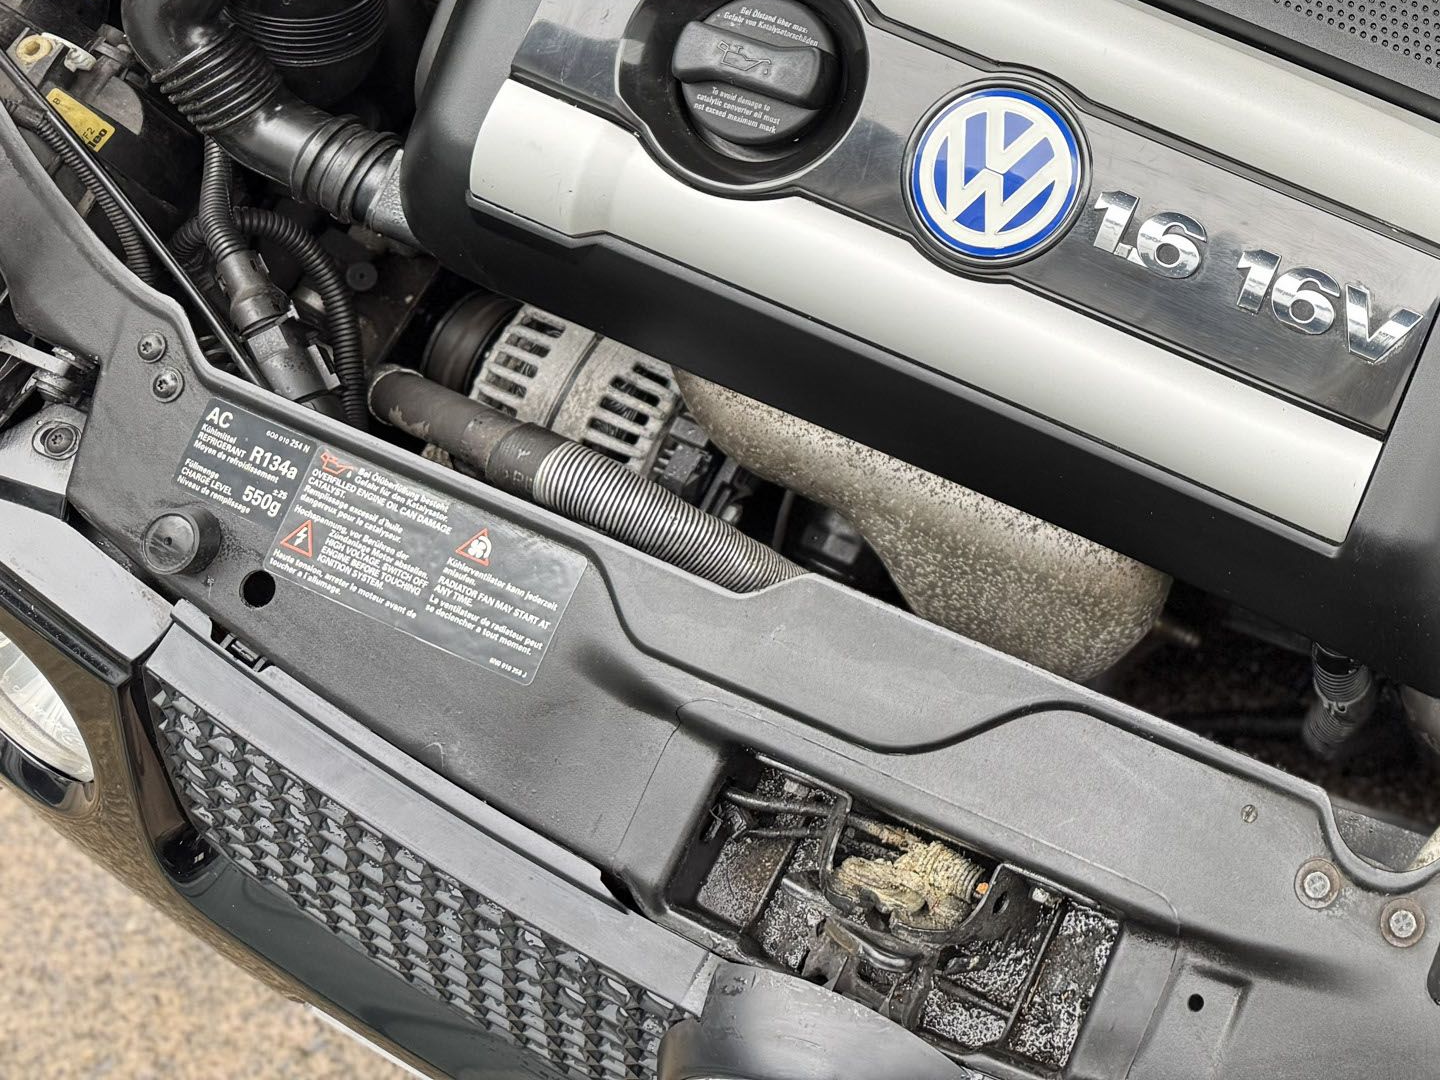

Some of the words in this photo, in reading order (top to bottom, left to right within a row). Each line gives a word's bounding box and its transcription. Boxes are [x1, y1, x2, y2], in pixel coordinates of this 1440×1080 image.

[724, 11, 744, 24] Gefahr
[740, 6, 751, 16] Bei
[697, 93, 722, 108] catalytic
[723, 101, 753, 116] converter
[763, 114, 781, 126] must
[720, 88, 737, 101] avoid
[738, 95, 763, 110] damage
[705, 105, 727, 119] exceed
[727, 112, 758, 129] maximum
[758, 122, 777, 134] mark
[920, 96, 1076, 247] VW
[1234, 246, 1423, 364] 16V
[198, 432, 246, 458] REFRIGERANT
[202, 423, 237, 444] Kühlmittel
[185, 458, 219, 479] Füllmenge
[194, 440, 216, 455] Moyen
[226, 456, 279, 483] refroidissement
[249, 446, 298, 480] R134a
[177, 475, 200, 491] Niveau
[210, 492, 250, 513] remplissage
[182, 467, 212, 485] CHARGE
[210, 480, 231, 495] LEVEL
[308, 477, 346, 498] CATALYST.
[354, 476, 378, 491] Gefahr
[380, 487, 391, 496] für
[391, 493, 405, 504] den
[358, 468, 372, 478] Bei
[372, 472, 422, 501] Ölüberfüllung
[420, 494, 448, 512] besteht
[242, 486, 281, 517] 550g
[300, 494, 337, 514] dangereux
[337, 511, 356, 522] pour
[303, 484, 348, 509] Remplissage
[349, 506, 379, 522] excessif
[378, 518, 403, 534] d'huile
[312, 468, 356, 492] OVERFILLED
[356, 488, 386, 506] ENGINE
[386, 501, 398, 512] OIL
[400, 507, 418, 520] CAN
[417, 514, 452, 535] DAMAGE
[328, 529, 370, 553] Zündanlage
[371, 548, 394, 563] Motor
[350, 530, 362, 539] vor
[362, 535, 395, 555] Berühren
[396, 550, 409, 560] der
[270, 558, 297, 574] toucher
[317, 554, 352, 574] IGNITION
[352, 570, 384, 590] SYSTEM.
[321, 546, 351, 564] ENGINE
[350, 559, 380, 577] BEFORE
[381, 572, 421, 596] TOUCHING
[325, 537, 345, 551] HIGH
[382, 563, 412, 582] SWITCH
[412, 576, 429, 588] OFF
[443, 567, 475, 586] anlaufen.
[273, 549, 294, 564] Haute
[358, 588, 384, 604] moteur
[385, 601, 406, 614] avant
[434, 584, 453, 597] ANY
[453, 592, 473, 607] TIME.
[446, 557, 506, 588] Kühlerventilator
[505, 583, 525, 597] kann
[524, 591, 558, 611] jederzeit
[438, 576, 478, 598] RADIATOR
[477, 593, 495, 606] FAN
[494, 600, 514, 613] MAY
[513, 608, 540, 624] START
[440, 600, 480, 622] ventilateur
[491, 623, 524, 641] radiateur
[524, 638, 543, 650] peut
[482, 628, 499, 641] tout
